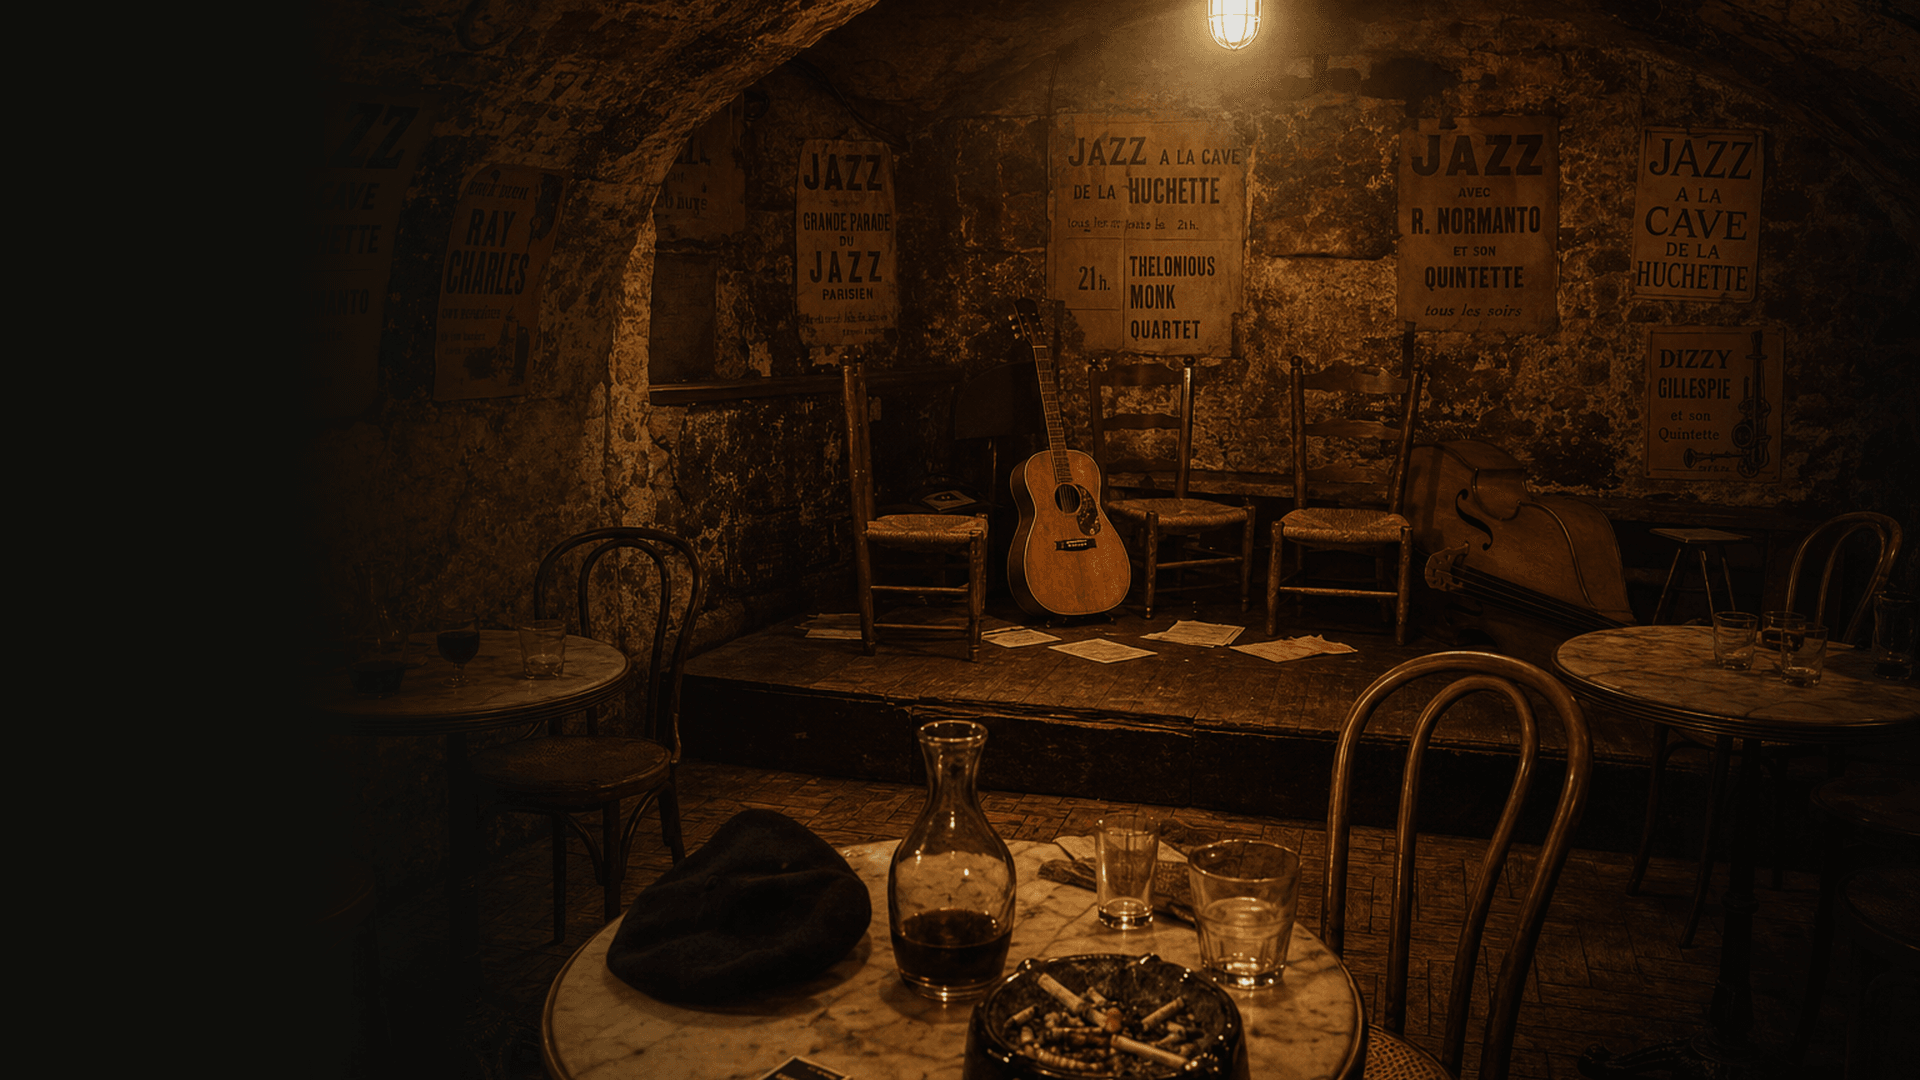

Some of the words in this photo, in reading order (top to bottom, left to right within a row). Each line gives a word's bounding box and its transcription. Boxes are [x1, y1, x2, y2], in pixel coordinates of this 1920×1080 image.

[1068, 136, 1147, 167] JAZZ
[1159, 149, 1170, 165] A
[1177, 149, 1195, 165] LA
[1202, 149, 1241, 165] CAVE
[1411, 134, 1543, 176] JAZZ
[1649, 138, 1753, 179] JAZZ
[803, 153, 883, 191] JAZZ
[1074, 184, 1091, 200] DE
[1098, 184, 1116, 200] LA
[1128, 177, 1220, 204] HUCHETTE
[1458, 187, 1491, 198] AVEC
[1675, 187, 1689, 202] A
[1698, 188, 1721, 203] LA
[465, 208, 517, 248] RAY
[803, 212, 847, 231] GRANDE
[850, 213, 891, 232] PARADE
[1411, 207, 1430, 234] R.
[1437, 206, 1541, 234] NORMANTO
[1645, 206, 1747, 240] CAVE
[839, 236, 854, 247] DU
[1453, 246, 1468, 256] ET
[1473, 246, 1496, 256] SON
[1665, 242, 1689, 257] DE
[1696, 243, 1720, 259] LA
[445, 249, 530, 295] CHARLES
[809, 250, 882, 283] JAZZ
[1129, 256, 1215, 277] THELONIOUS
[1636, 261, 1749, 291] HUCHETTE
[1424, 266, 1524, 291] QUINTETTE
[822, 288, 874, 300] PARISIEN
[1130, 284, 1176, 309] MONK
[1424, 304, 1455, 316] tous
[1487, 304, 1522, 317] soirs
[1131, 320, 1200, 341] QUARTET
[1659, 349, 1733, 369] DIZZY
[1658, 377, 1731, 399] GILLESPIE
[1670, 411, 1683, 421] et
[1689, 412, 1711, 421] son
[1658, 427, 1720, 442] Quintette
